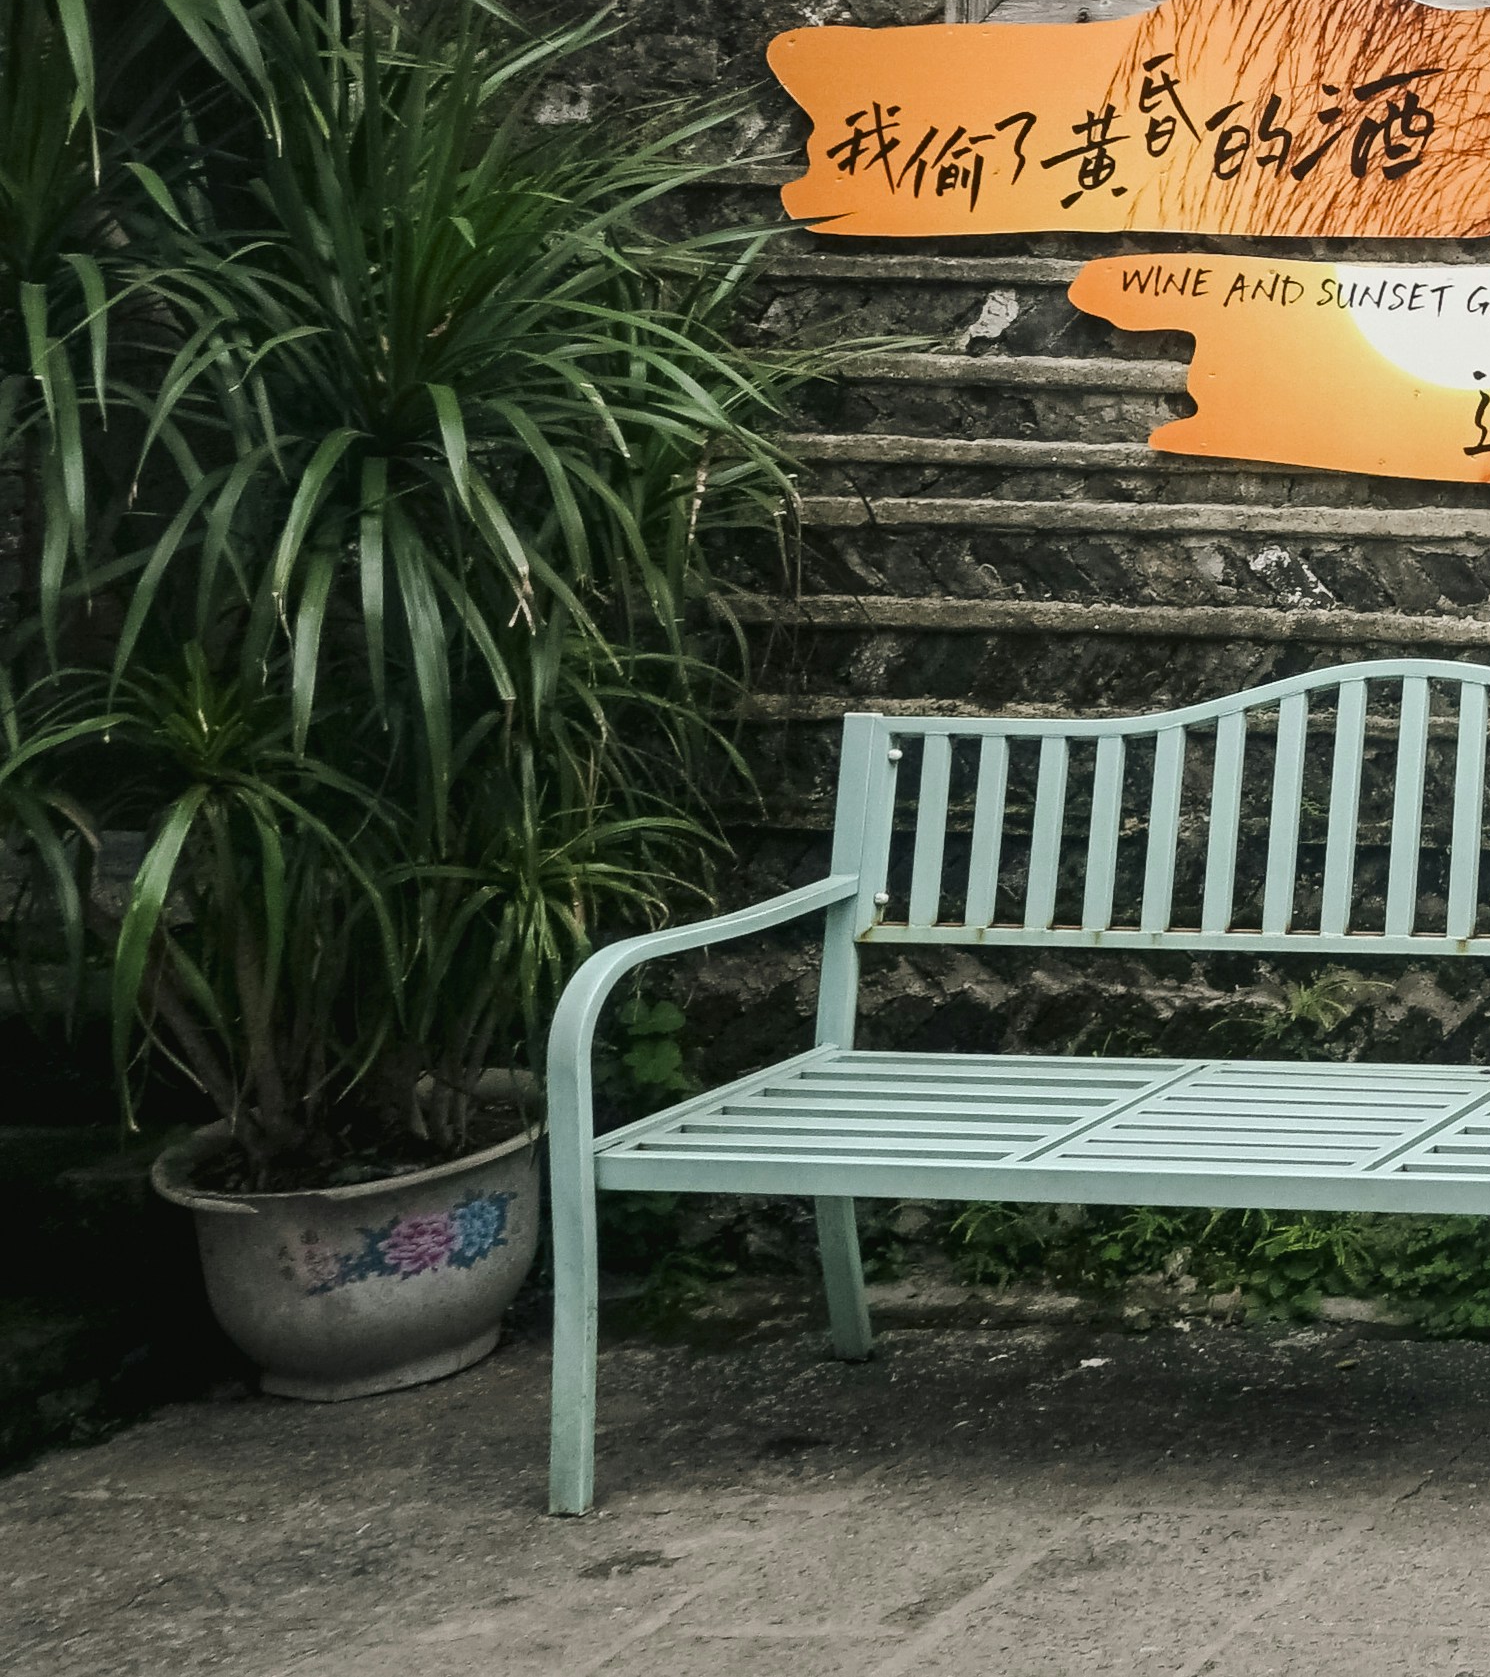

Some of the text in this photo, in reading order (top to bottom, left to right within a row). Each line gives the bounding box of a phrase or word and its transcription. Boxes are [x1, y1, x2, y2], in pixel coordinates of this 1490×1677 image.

[825, 53, 1445, 211] 我偷了黄昏的酒
[1120, 266, 1213, 301] WINE
[1223, 271, 1305, 310] AND
[1313, 277, 1456, 317] SUNSET
